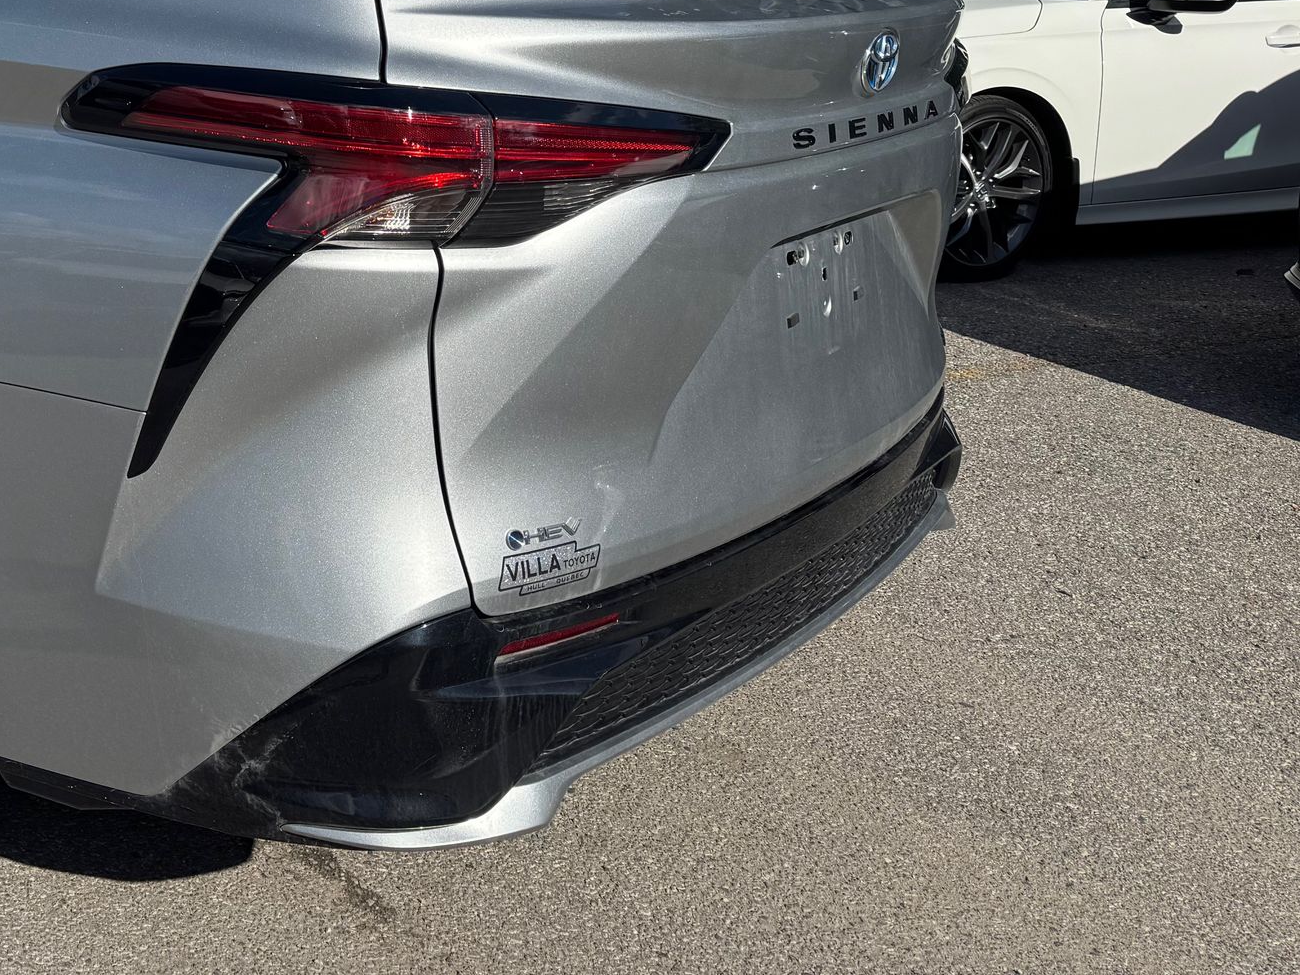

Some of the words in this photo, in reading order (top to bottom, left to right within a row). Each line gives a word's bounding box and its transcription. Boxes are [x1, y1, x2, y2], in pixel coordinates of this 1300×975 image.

[792, 100, 939, 150] SIENNA
[523, 516, 583, 545] HEV
[506, 553, 562, 582] VILLA
[563, 552, 596, 570] TOYOTA
